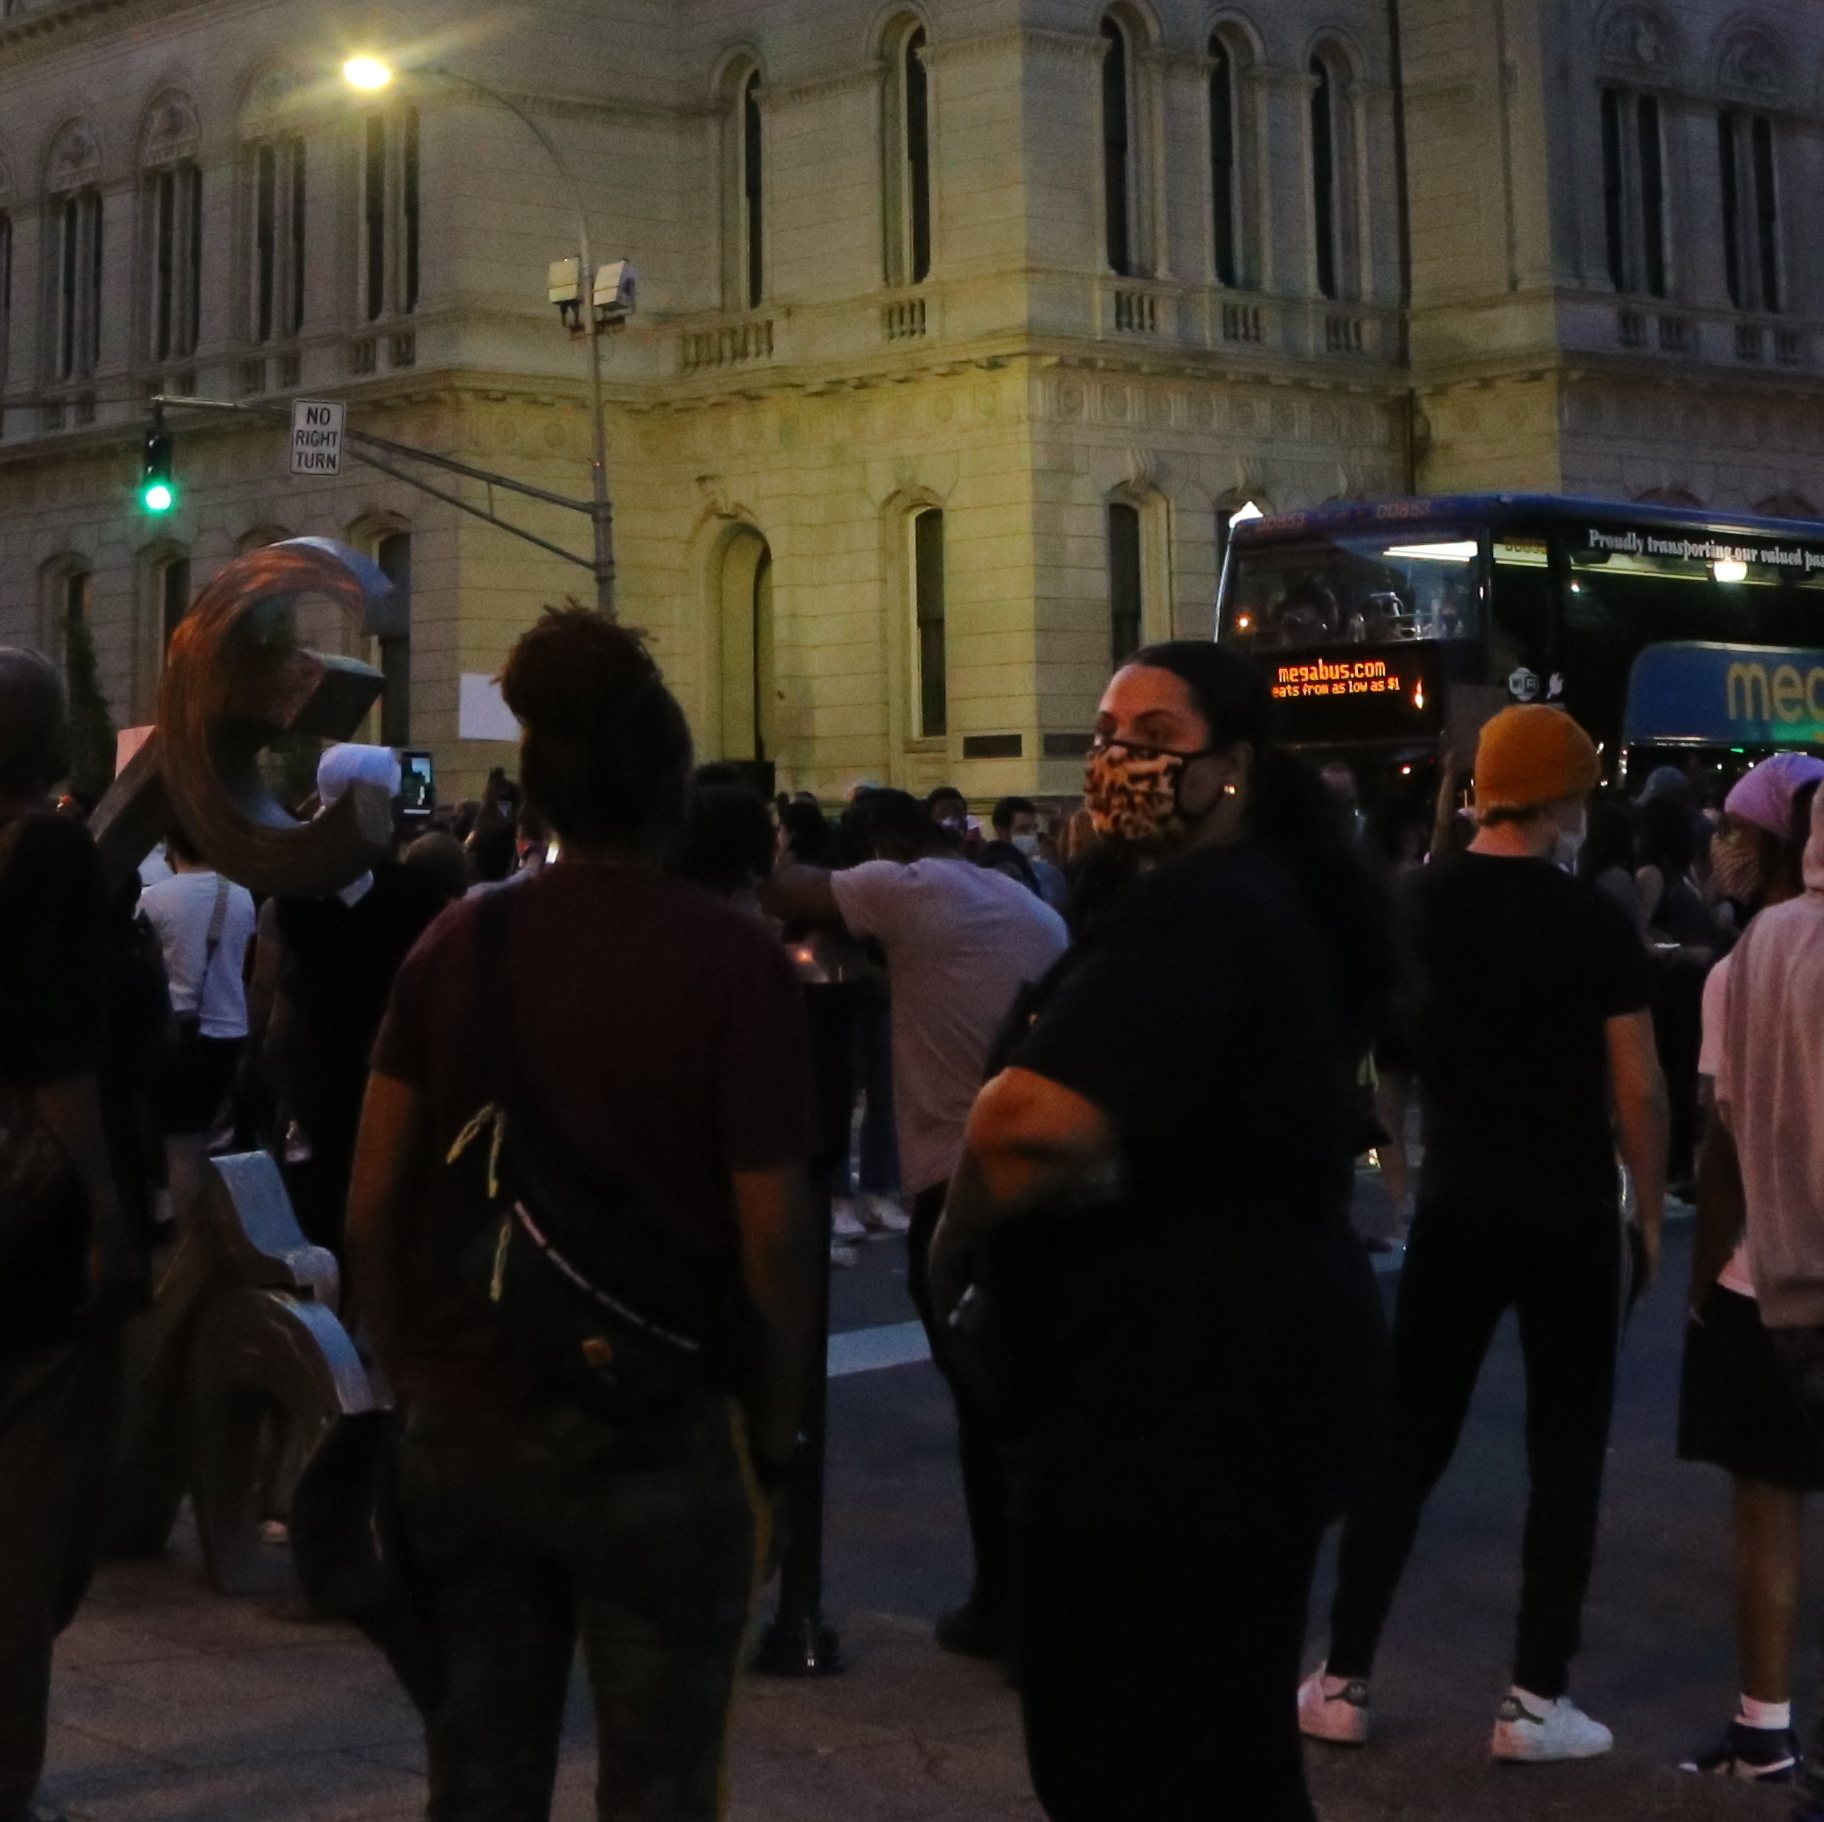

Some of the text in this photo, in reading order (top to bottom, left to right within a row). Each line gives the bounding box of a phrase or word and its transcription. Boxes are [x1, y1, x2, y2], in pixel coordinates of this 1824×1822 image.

[306, 407, 331, 426] NO
[295, 430, 338, 447] RIGHT
[296, 452, 336, 469] TURN
[1588, 528, 1644, 556] Proudly
[1647, 535, 1733, 562] transporting
[1735, 546, 1758, 562] our
[1760, 546, 1803, 565] valued
[1278, 658, 1386, 682] megabus.com
[1303, 683, 1329, 695] from
[1332, 682, 1346, 694] as
[1348, 680, 1368, 693] low
[1370, 680, 1385, 692] as
[1387, 677, 1400, 690] $1
